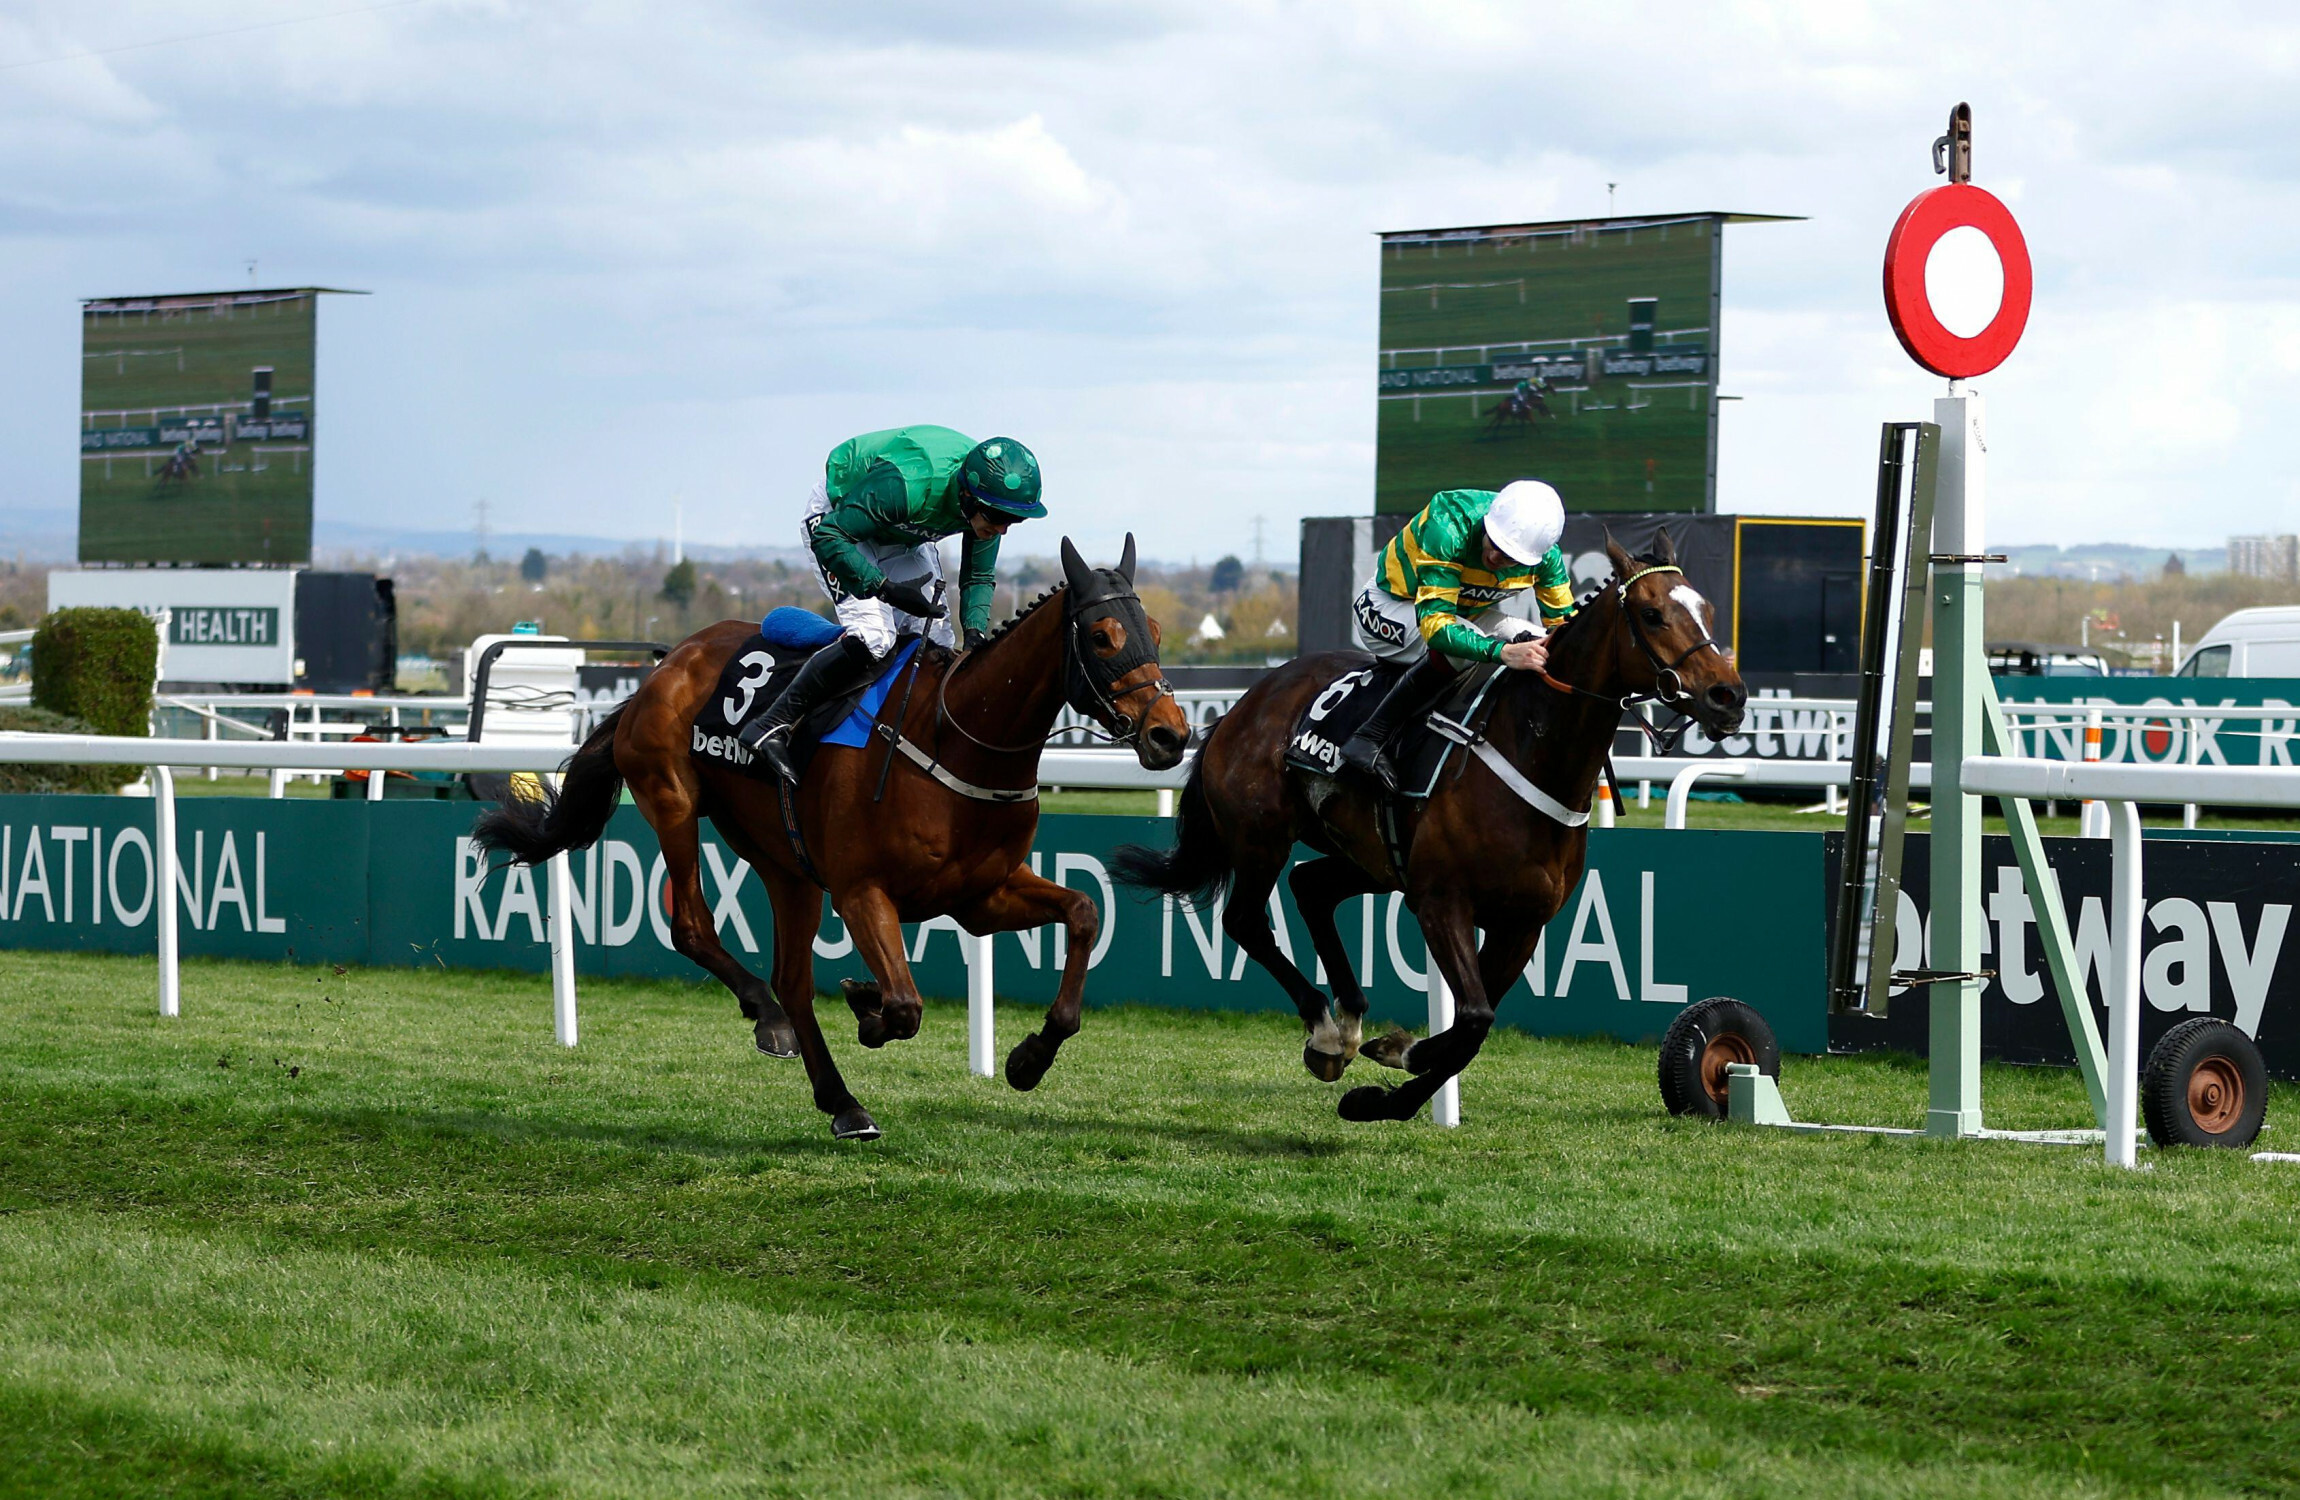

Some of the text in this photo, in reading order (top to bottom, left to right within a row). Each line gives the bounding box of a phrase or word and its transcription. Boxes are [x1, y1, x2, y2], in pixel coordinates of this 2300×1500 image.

[808, 515, 845, 601] ROX
[180, 610, 268, 643] HEALTH
[1355, 593, 1404, 645] RANDOX
[723, 650, 776, 726] 3
[1309, 669, 1374, 721] 6
[693, 725, 755, 766] betw
[1290, 730, 1346, 774] way
[1682, 688, 1858, 758] betwa
[2003, 696, 2237, 765] ANDOX
[1888, 865, 2293, 1042] tway
